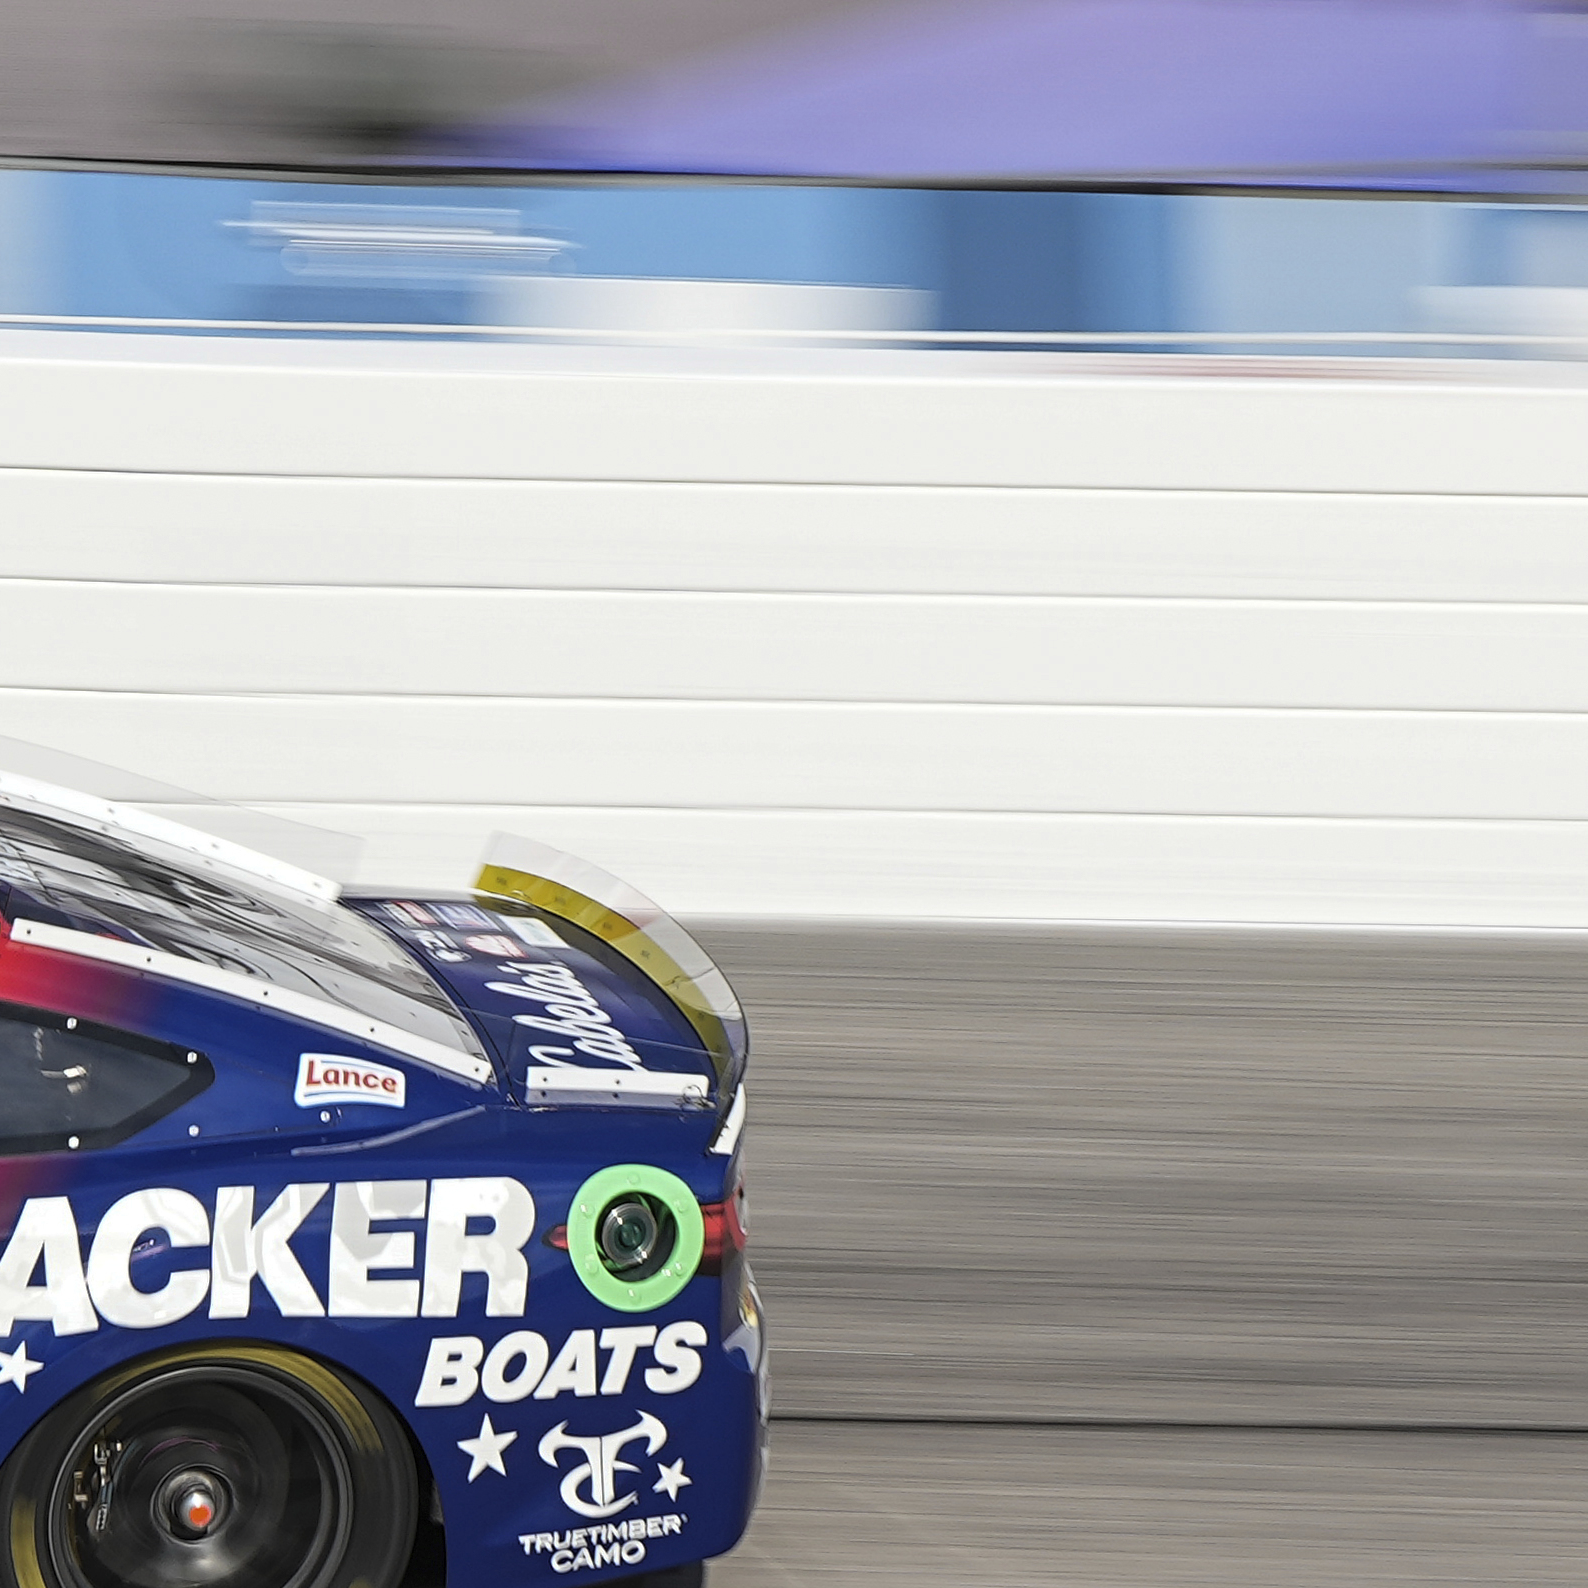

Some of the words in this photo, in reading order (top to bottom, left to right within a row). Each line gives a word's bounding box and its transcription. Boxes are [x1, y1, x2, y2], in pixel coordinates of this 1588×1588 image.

[306, 1060, 398, 1093] Lance
[414, 1320, 708, 1408] BOATS
[517, 1513, 684, 1556] TRUETIMBER
[550, 1539, 648, 1574] CAMO
